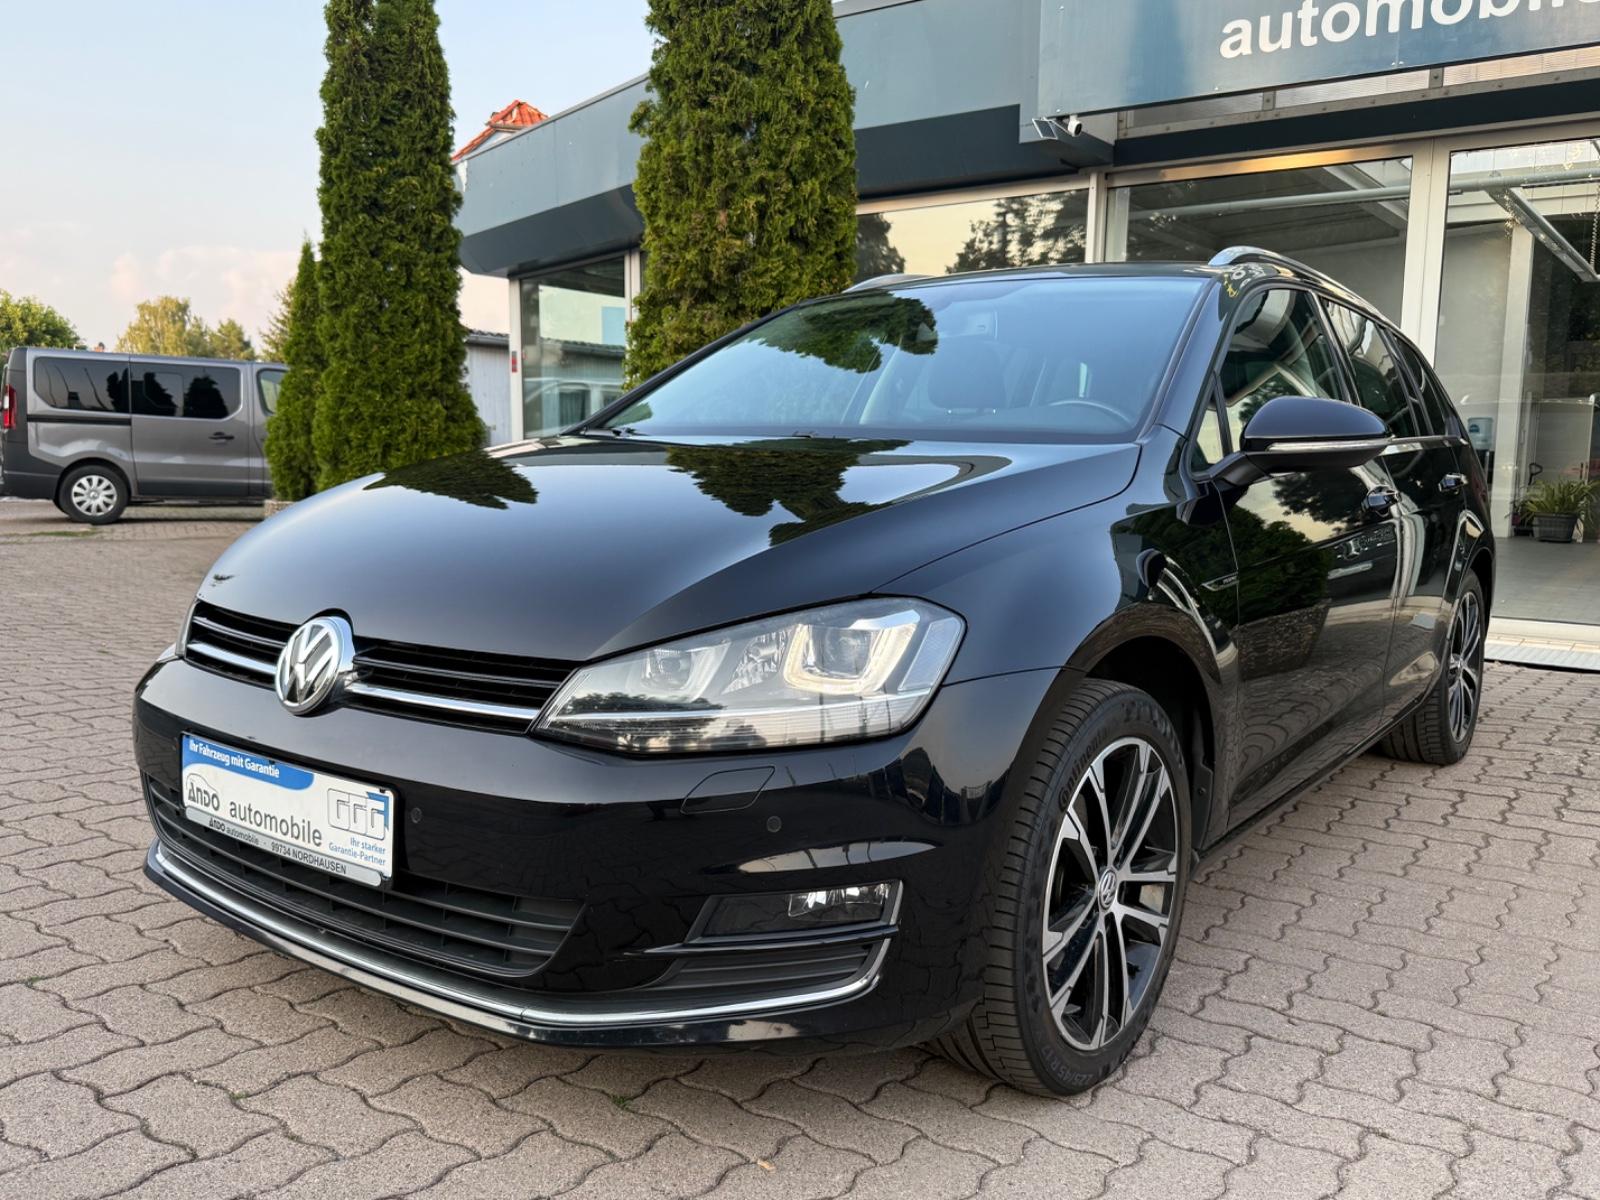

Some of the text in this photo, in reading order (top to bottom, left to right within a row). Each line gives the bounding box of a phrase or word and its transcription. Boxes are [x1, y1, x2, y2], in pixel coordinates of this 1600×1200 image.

[1219, 0, 1600, 60] automo
[189, 739, 280, 778] Ihr Fahrzeug mit Garantie
[229, 801, 322, 847] automobile
[226, 826, 260, 846] automobile
[270, 841, 291, 857] 99734
[291, 849, 348, 875] NORDHAUSEN
[328, 842, 386, 866] Garantie-Partner
[360, 842, 386, 855] starker
